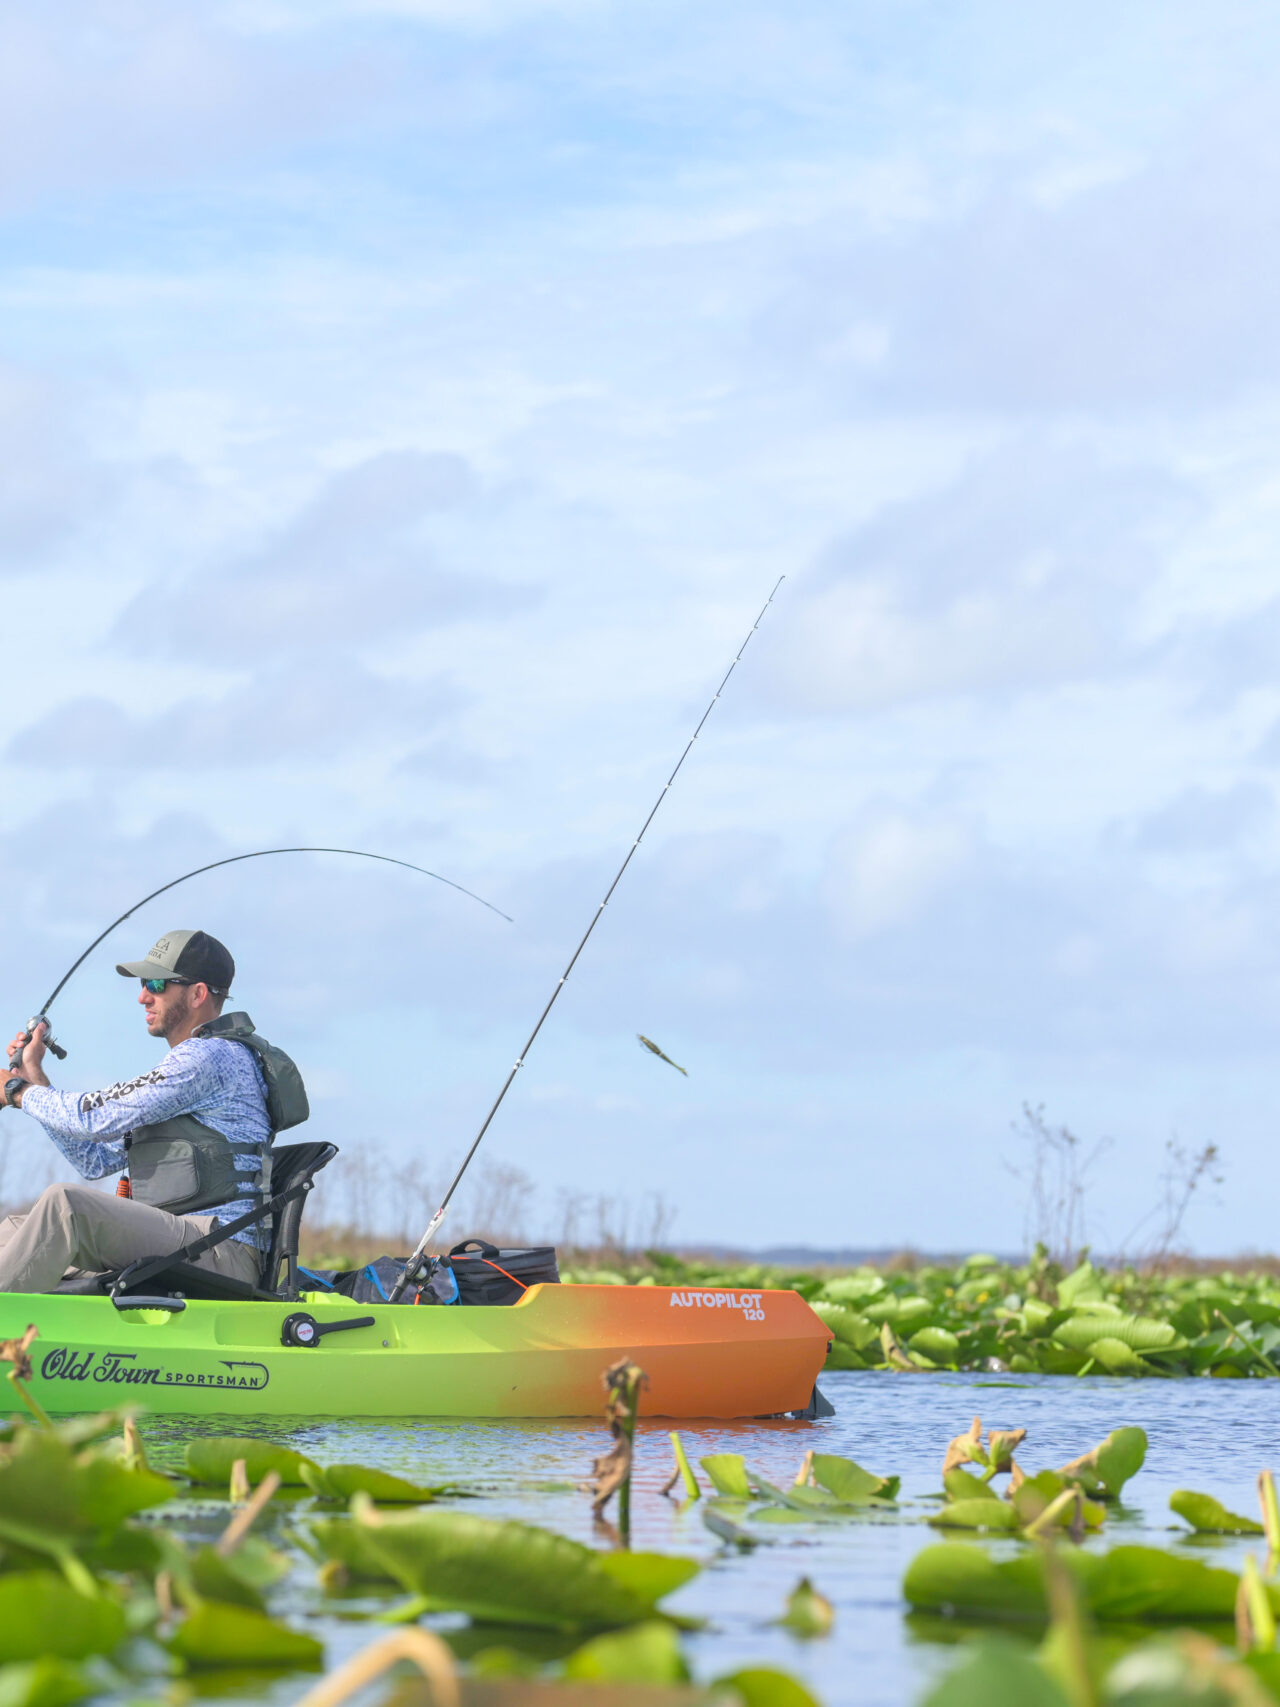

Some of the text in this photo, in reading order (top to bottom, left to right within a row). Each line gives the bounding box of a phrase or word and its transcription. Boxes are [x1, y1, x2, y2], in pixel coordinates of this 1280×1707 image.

[670, 1292, 762, 1309] AUTOPILOT
[742, 1308, 765, 1321] 120
[41, 1346, 258, 1387] Old Town SPORTSMAN
